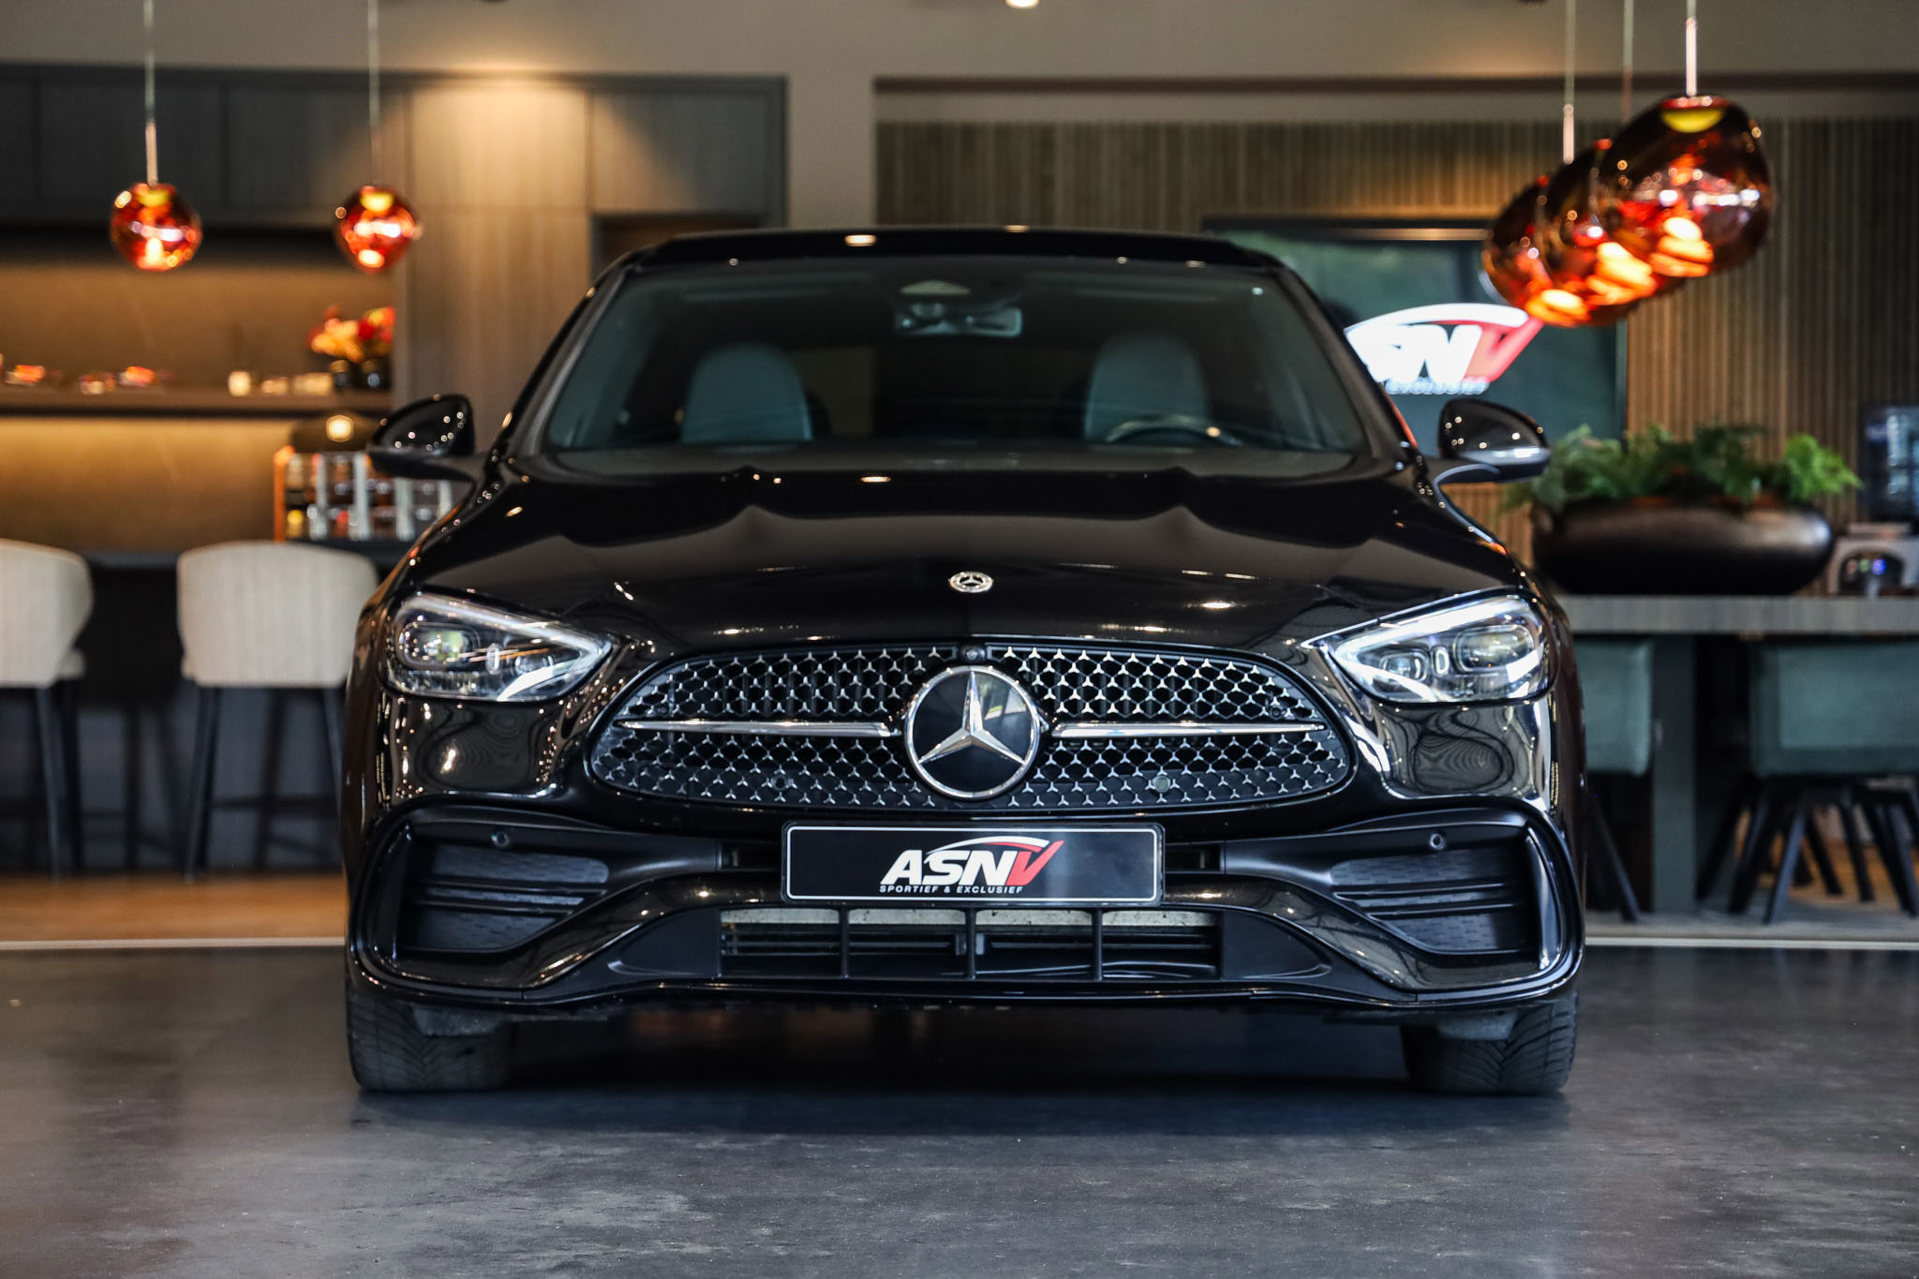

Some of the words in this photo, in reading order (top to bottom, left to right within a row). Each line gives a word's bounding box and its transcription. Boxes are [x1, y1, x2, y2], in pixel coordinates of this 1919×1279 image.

[880, 839, 1065, 886] ASNV
[879, 885, 939, 893] SPORTIEF
[956, 886, 1023, 894] EXCLUSIEF
